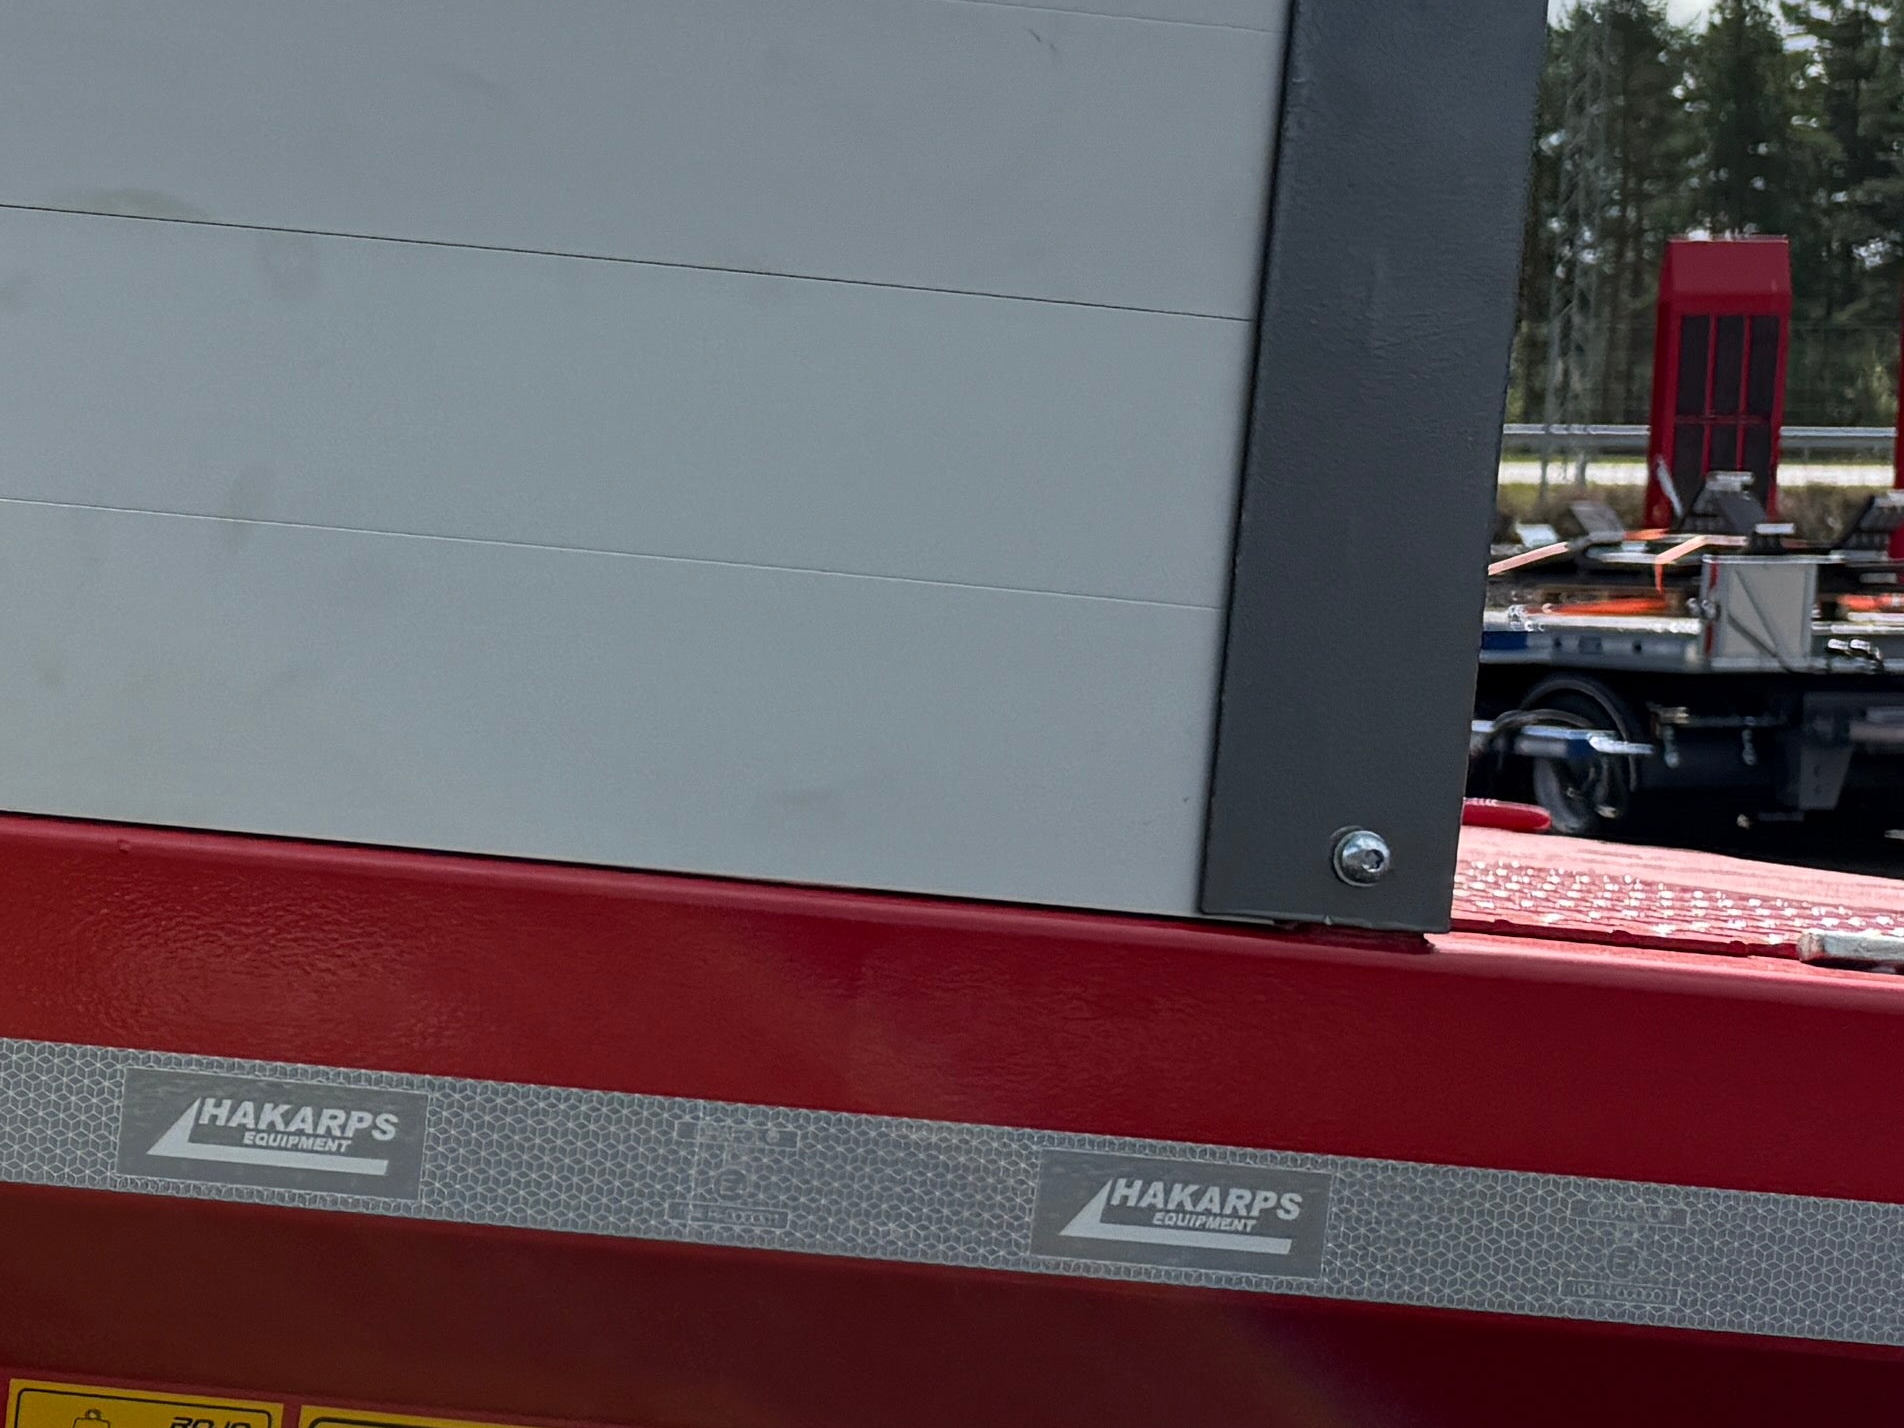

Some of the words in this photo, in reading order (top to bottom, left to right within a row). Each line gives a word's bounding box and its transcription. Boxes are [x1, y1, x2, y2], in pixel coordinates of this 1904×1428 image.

[198, 1097, 399, 1141] HAKARPS
[243, 1130, 352, 1152] EQUIPMENT
[1109, 1177, 1303, 1221] HAKARPS
[1151, 1211, 1257, 1233] EQUIPMENT
